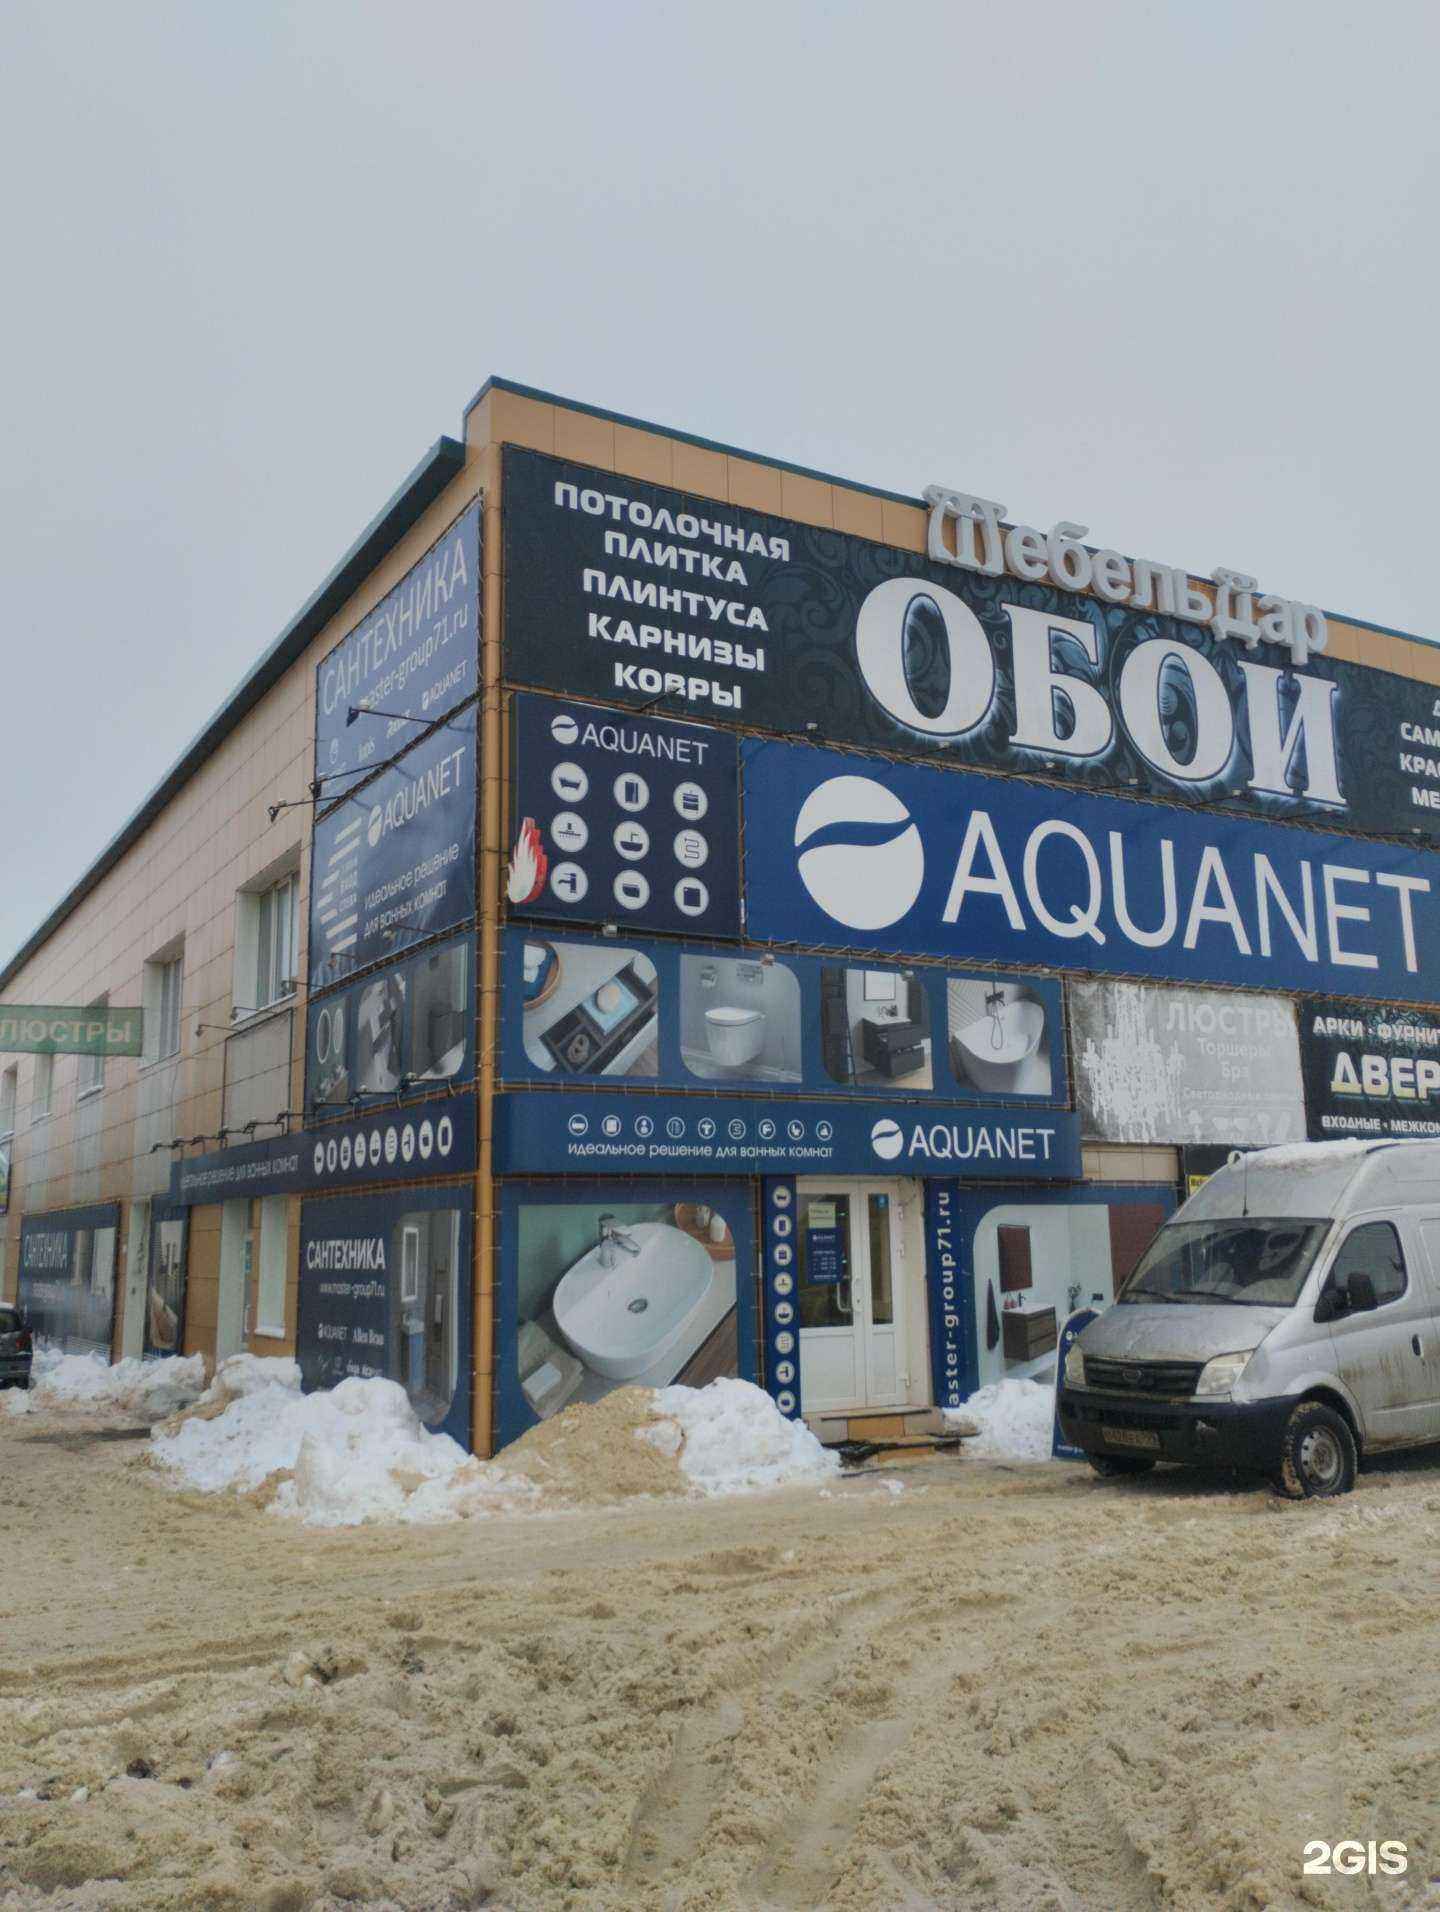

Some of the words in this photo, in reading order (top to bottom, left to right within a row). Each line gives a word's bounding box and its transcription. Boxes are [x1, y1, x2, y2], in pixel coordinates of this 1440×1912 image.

[554, 481, 790, 561] ПОТОЛОЧНАЯ
[605, 531, 747, 585] ПЛИТКА
[583, 569, 768, 632] ПЛИНТУСА
[323, 538, 467, 715] САНТЕХНИКА
[588, 613, 765, 671] КАРНИЗЫ
[361, 604, 469, 710] aster-group71.ru
[614, 662, 742, 709] КОВРЫ
[855, 577, 1348, 806] ОБОИ
[581, 723, 709, 765] AQUANET
[382, 746, 466, 836] AQUANET
[942, 810, 1431, 973] AQUANET
[0, 1020, 131, 1042] ЛЮСТРЫ
[1313, 1016, 1364, 1037] АРКИ
[1330, 1051, 1440, 1099] ДВЕР
[909, 1124, 1056, 1161] AQUANET
[1322, 1115, 1381, 1130] ВХОДНЫЕ
[568, 1142, 645, 1156] идеальное
[650, 1143, 712, 1160] решение
[716, 1146, 737, 1159] для
[740, 1146, 786, 1158] ванных
[789, 1146, 832, 1158] комнат
[307, 1238, 386, 1270] САНТЕХНИКА
